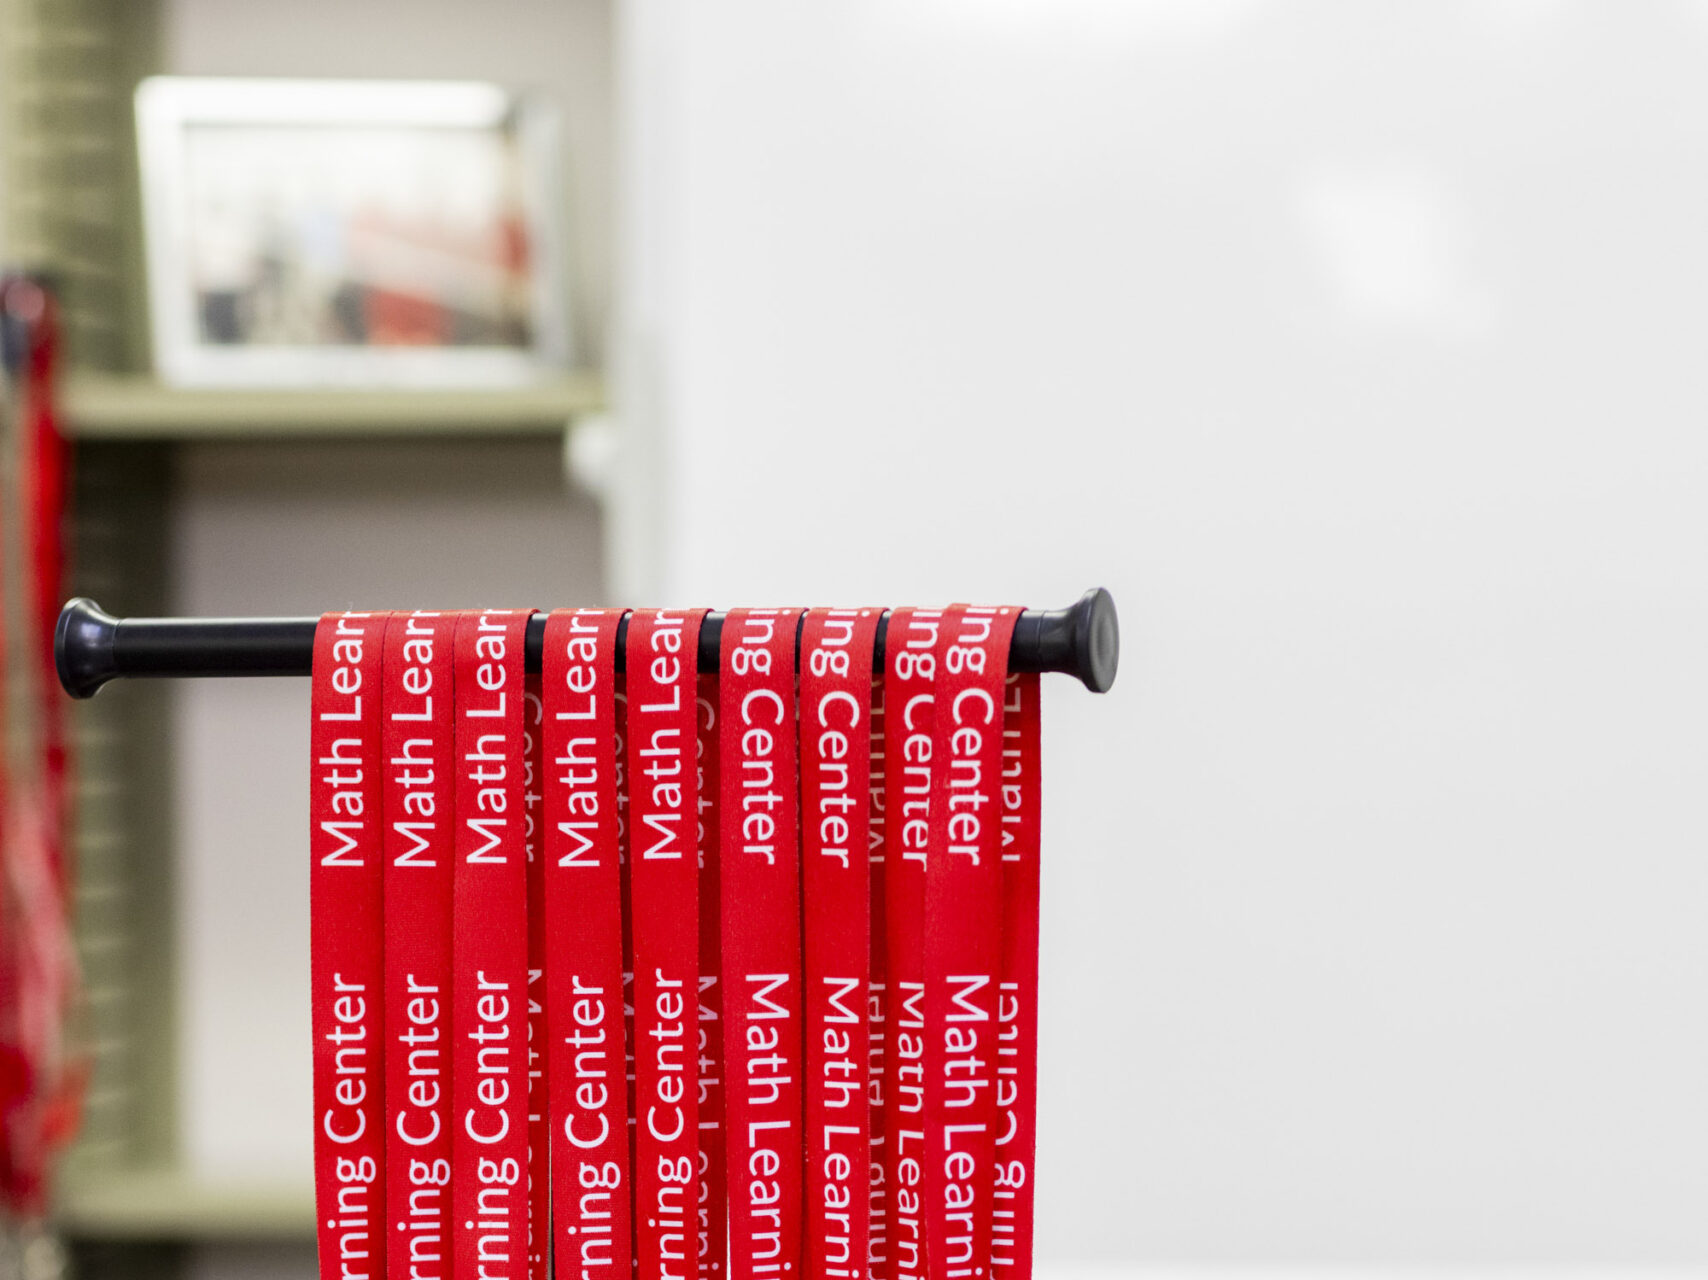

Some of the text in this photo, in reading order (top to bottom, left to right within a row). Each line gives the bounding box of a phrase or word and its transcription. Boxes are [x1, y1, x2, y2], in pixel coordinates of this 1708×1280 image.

[319, 738, 364, 866] Math
[390, 738, 436, 867] Math
[465, 734, 507, 863] Math
[555, 737, 600, 867] Math
[639, 728, 682, 860] Math
[741, 688, 784, 866] Center
[818, 690, 860, 868] Center
[947, 688, 994, 866] Center
[324, 972, 366, 1144] Center
[396, 973, 441, 1146] Center
[465, 970, 509, 1144] Center
[565, 975, 609, 1149] Center
[647, 968, 684, 1142] Center
[745, 973, 792, 1105] Math
[823, 977, 861, 1108] Math
[943, 975, 990, 1108] Math
